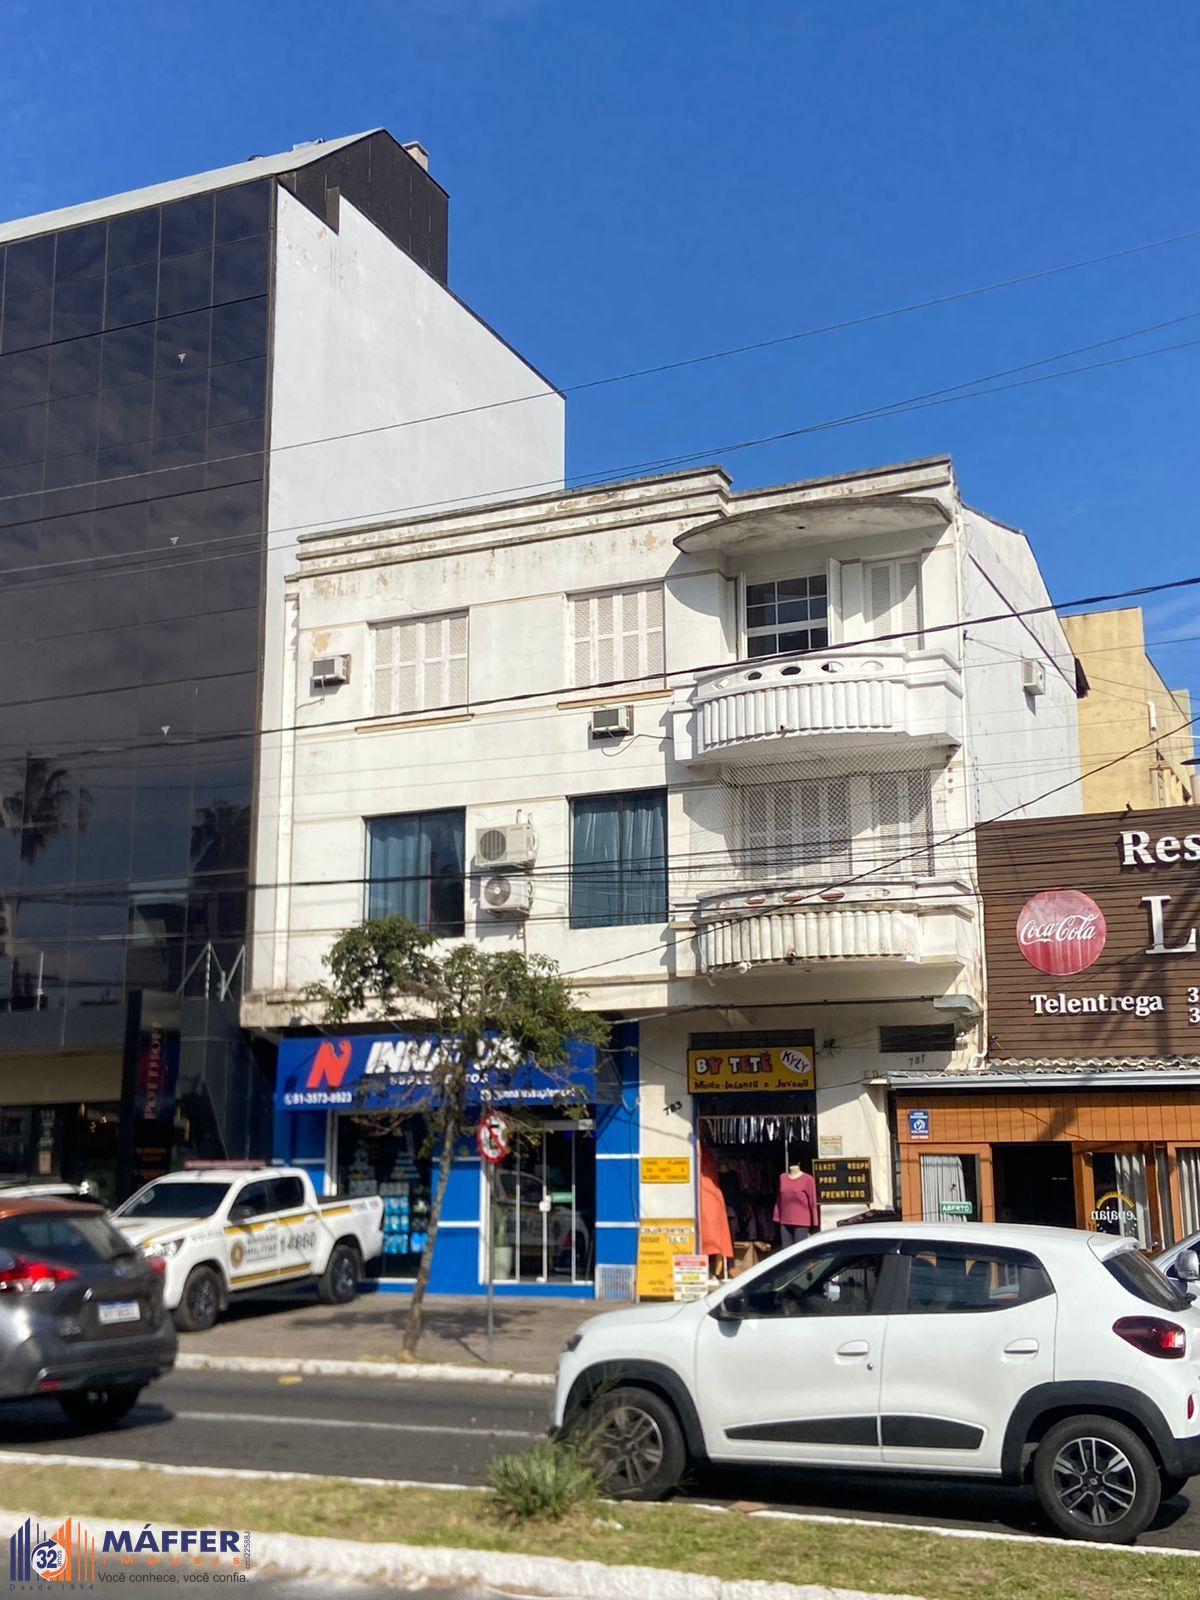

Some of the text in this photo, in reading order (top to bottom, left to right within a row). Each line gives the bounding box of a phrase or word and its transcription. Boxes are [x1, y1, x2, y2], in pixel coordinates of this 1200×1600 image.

[1120, 831, 1200, 866] Res
[1020, 914, 1098, 945] Coca-Cola
[1030, 993, 1164, 1017] Telentrega
[695, 1056, 723, 1075] BY
[782, 1050, 810, 1073] KYLY
[694, 1080, 720, 1090] Moda
[724, 1080, 759, 1090] Infantil
[775, 1079, 809, 1089] Juvenil
[663, 1101, 683, 1116] 783
[942, 1204, 970, 1213] ABERTO
